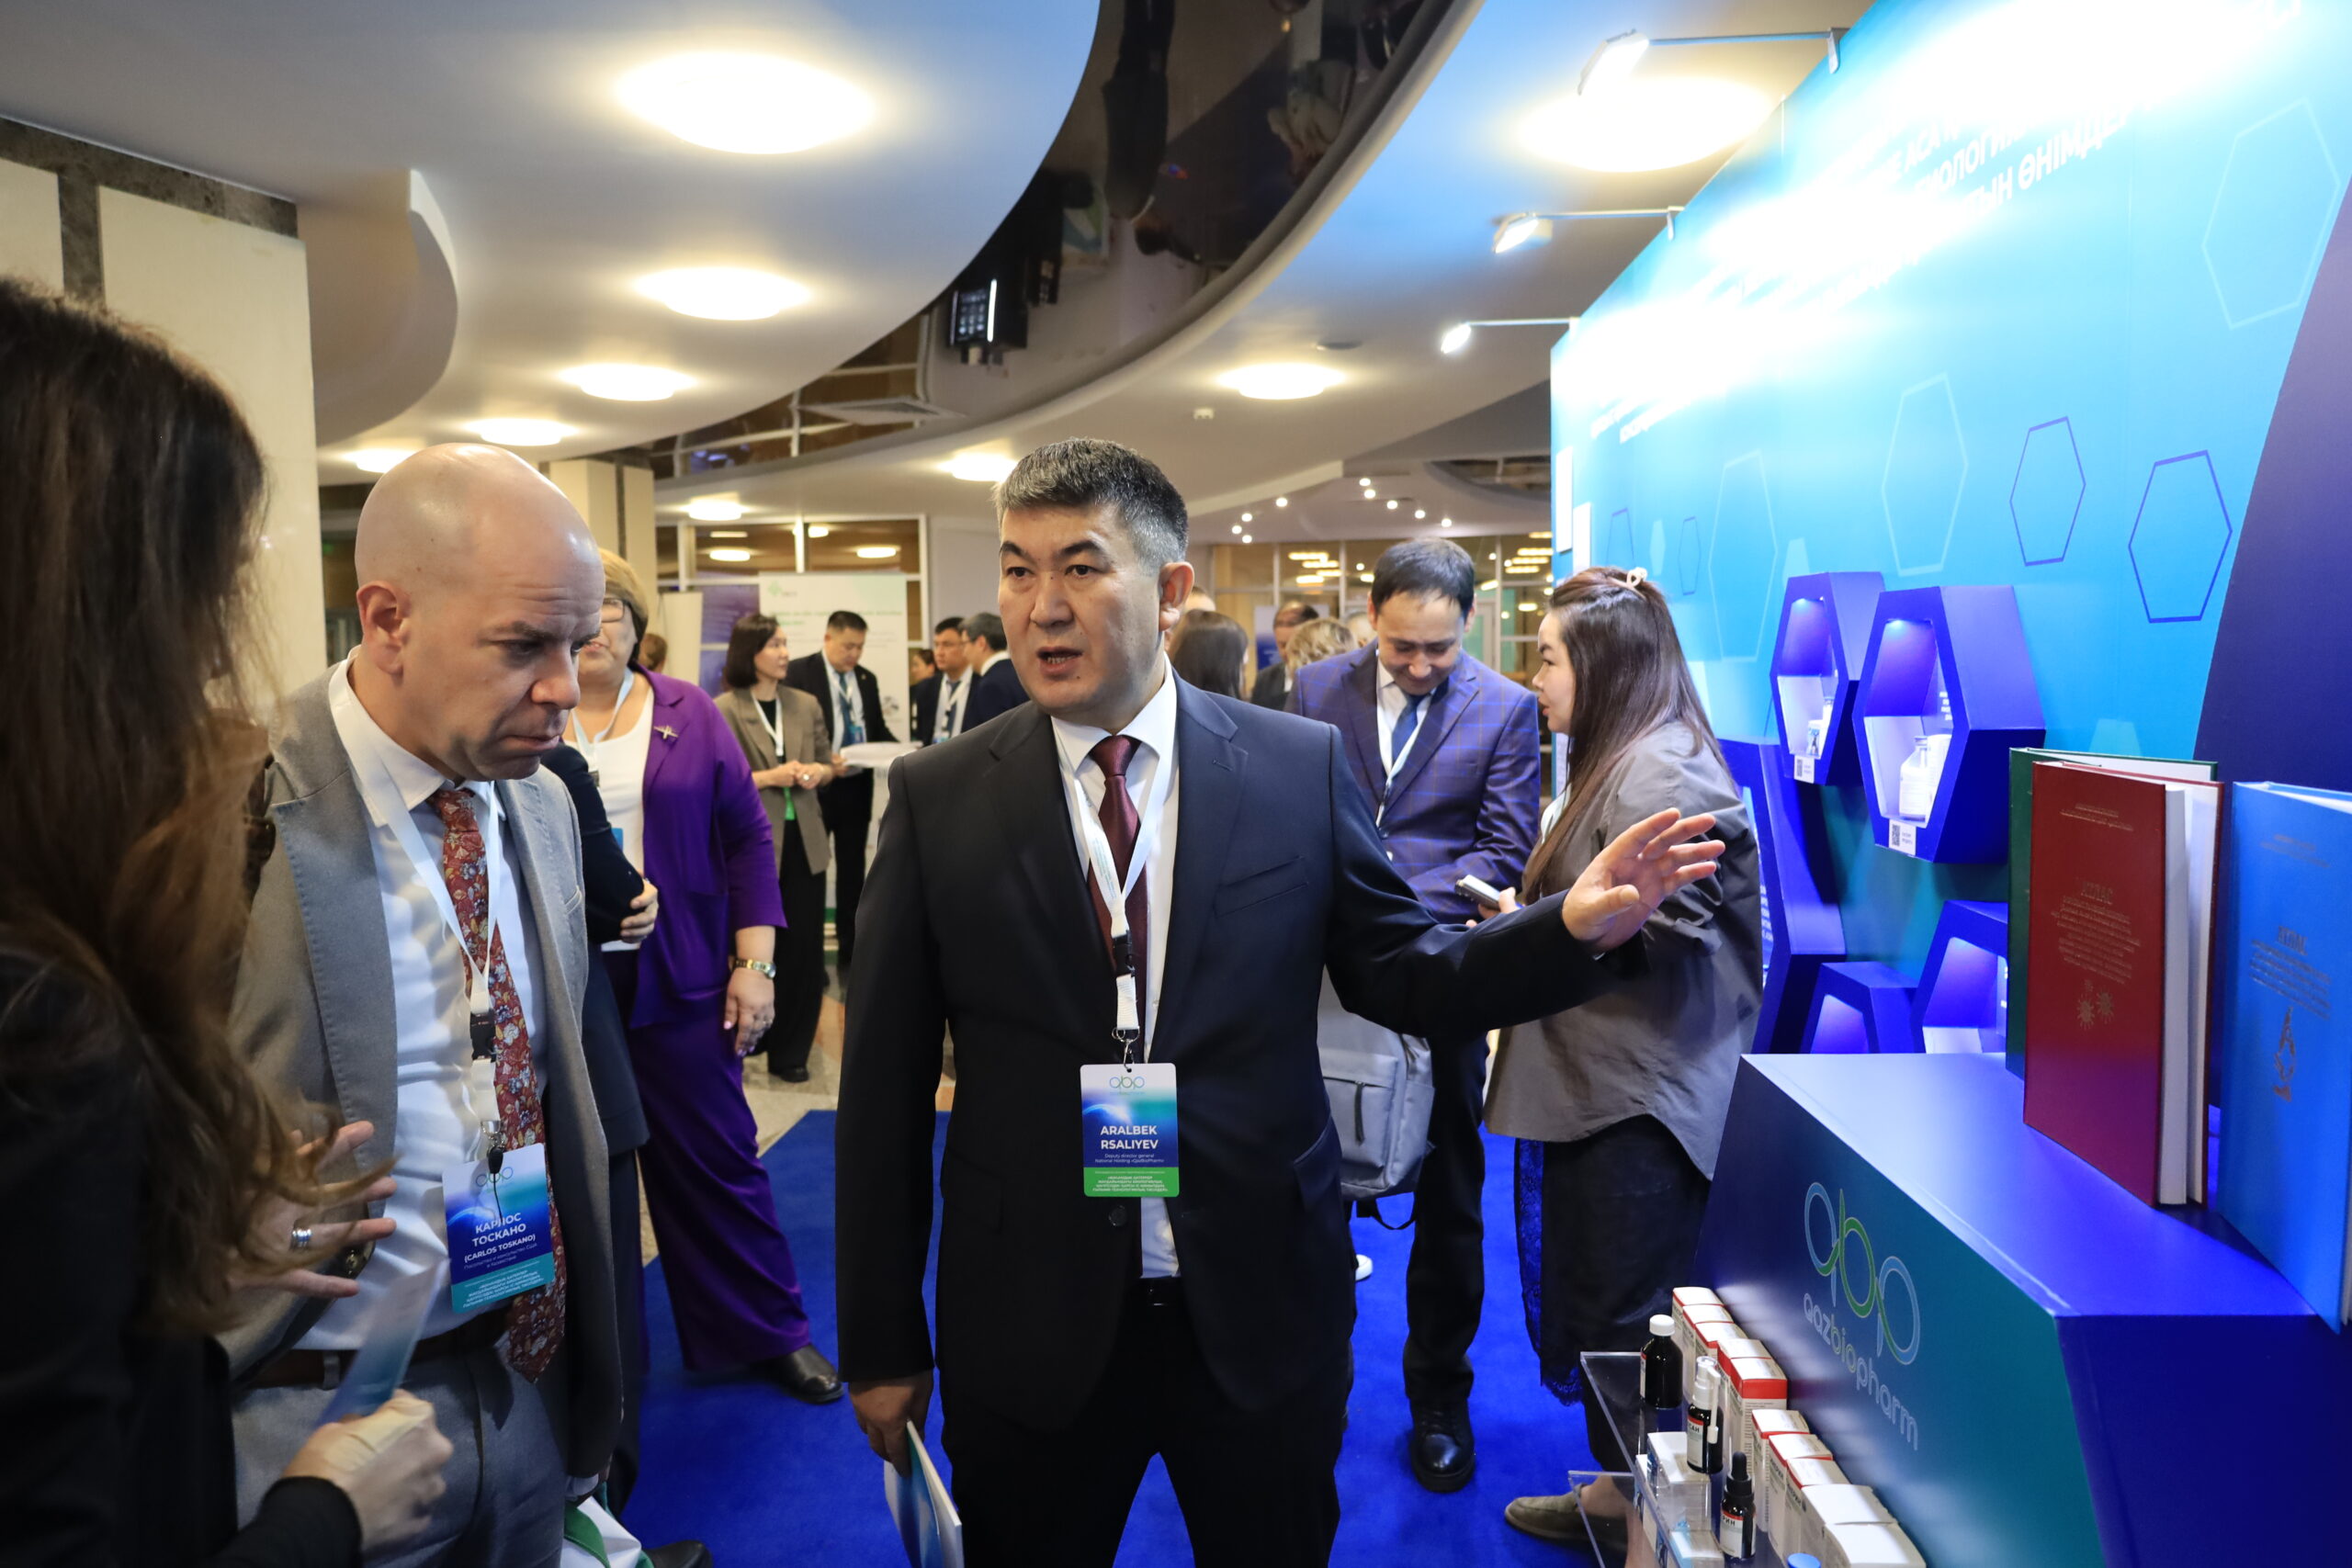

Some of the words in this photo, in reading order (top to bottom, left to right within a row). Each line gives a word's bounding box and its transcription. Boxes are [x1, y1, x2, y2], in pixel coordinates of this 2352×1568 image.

[1100, 1125, 1158, 1135] ARALBEK
[1101, 1139, 1159, 1149] RSALIYEV
[471, 1223, 526, 1247] ТОСКАНО
[464, 1246, 497, 1263] (CARLOS
[498, 1234, 536, 1251] TOSKANO)
